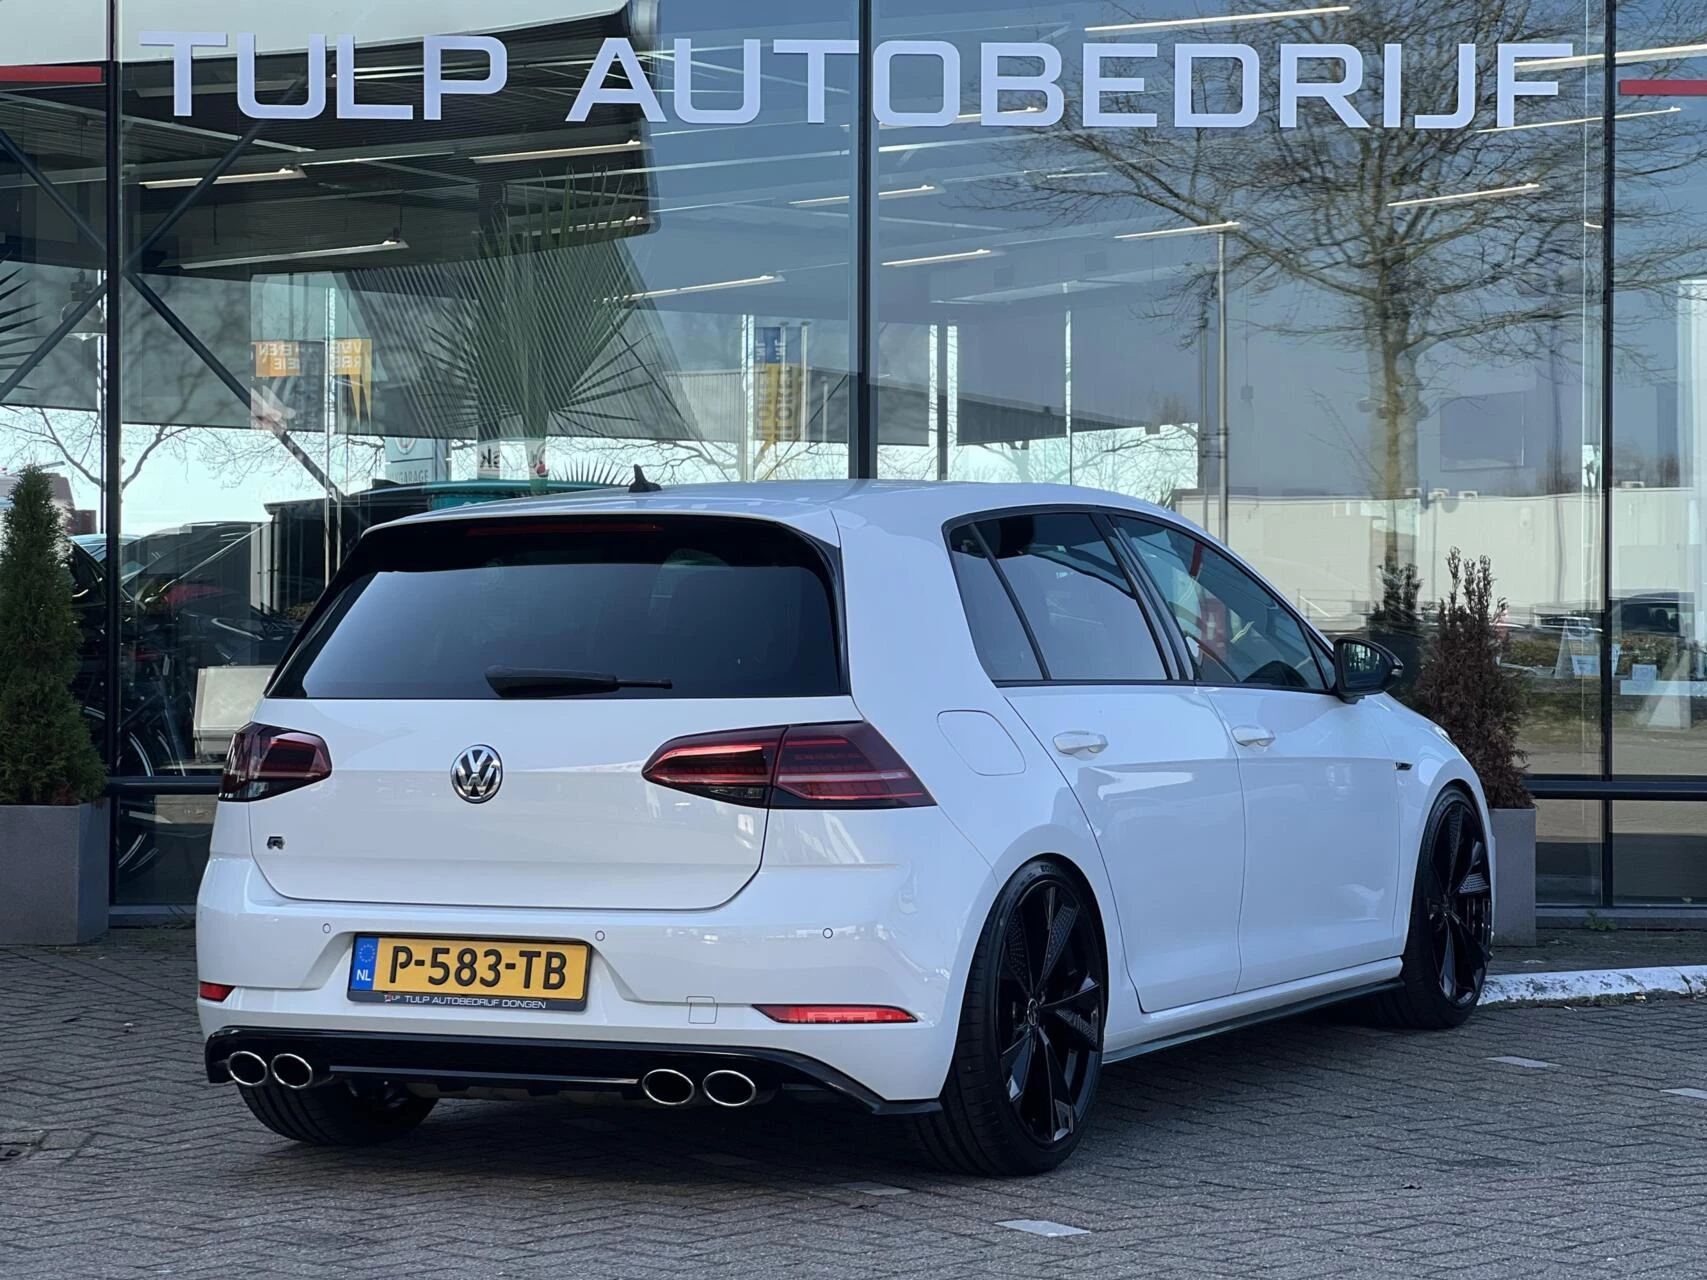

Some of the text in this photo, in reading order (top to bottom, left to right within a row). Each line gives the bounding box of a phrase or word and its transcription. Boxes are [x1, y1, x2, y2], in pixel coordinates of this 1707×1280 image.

[139, 31, 1574, 129] TULP AUTOBEDRIJF
[356, 969, 372, 982] NL
[388, 945, 568, 990] P-583-TB
[404, 994, 547, 1010] TULP AUTOBEDRIJF DONGEN
